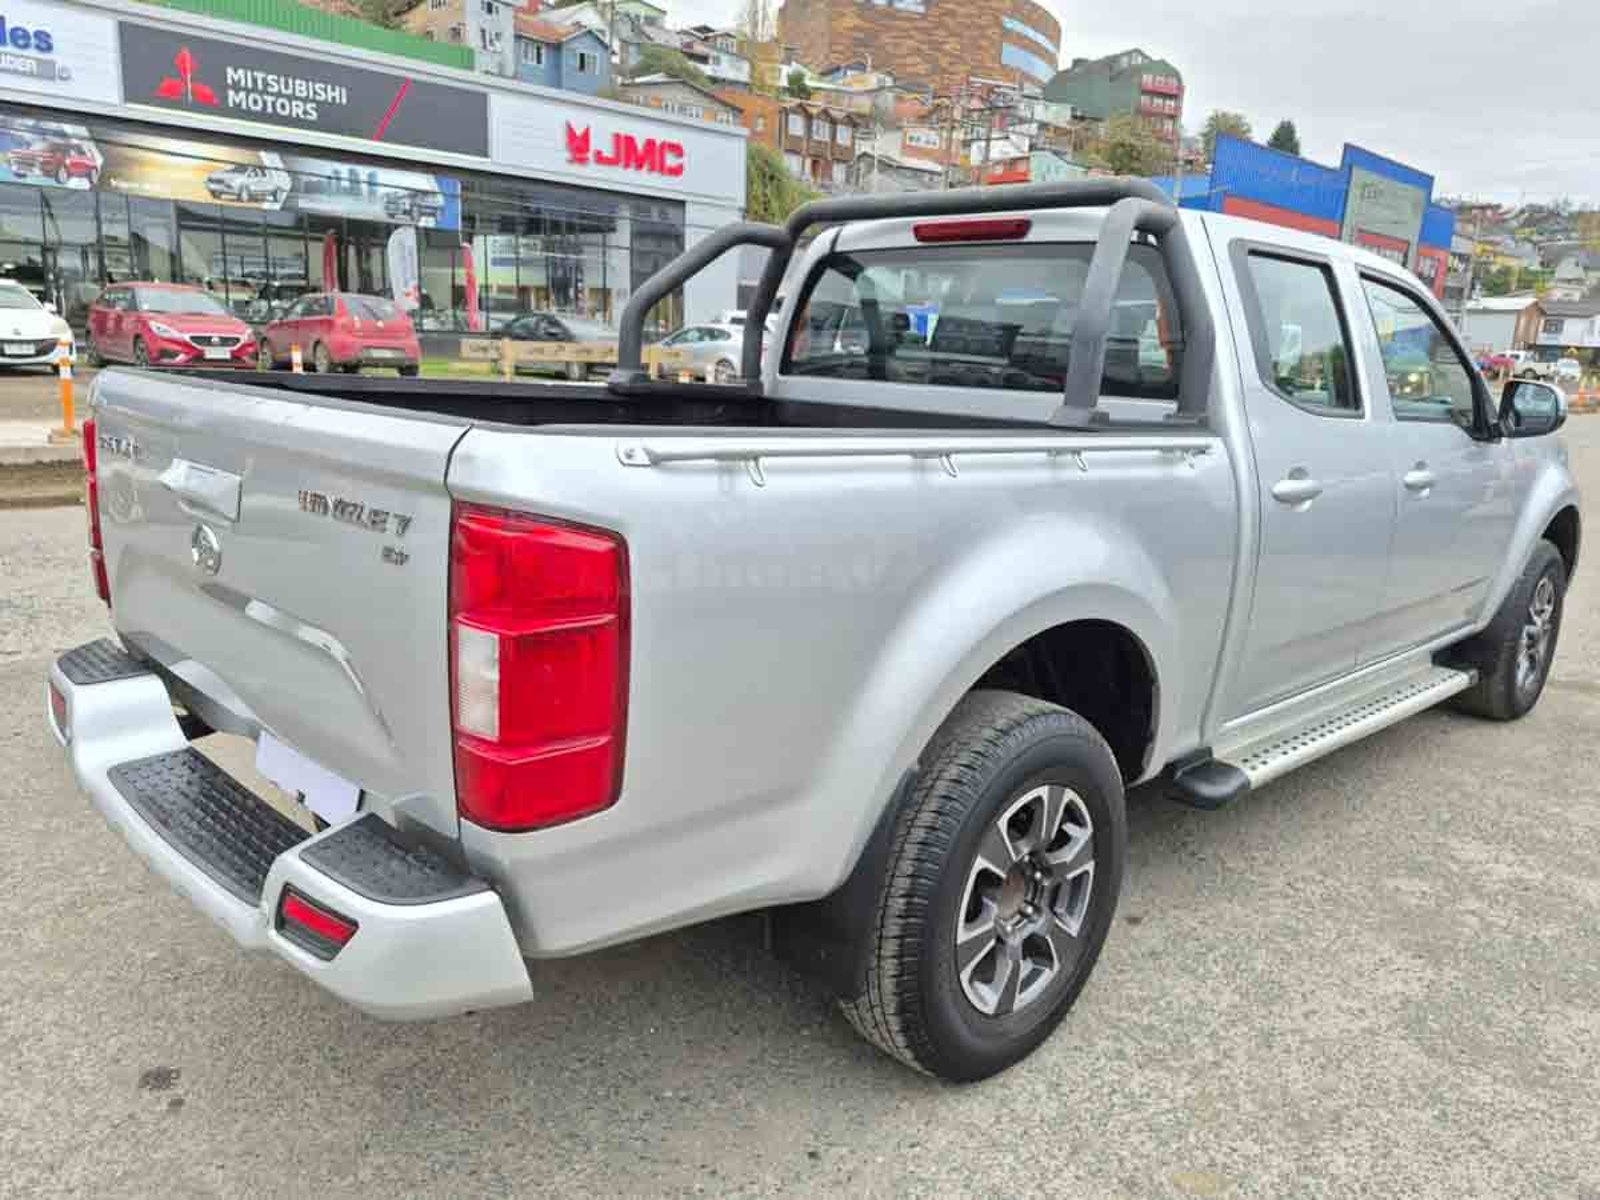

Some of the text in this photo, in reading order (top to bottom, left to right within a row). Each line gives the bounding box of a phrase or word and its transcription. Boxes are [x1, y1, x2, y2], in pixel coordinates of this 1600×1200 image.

[225, 67, 348, 105] MITSUBISHI
[227, 91, 319, 121] MOTORS
[595, 133, 685, 177] JMC
